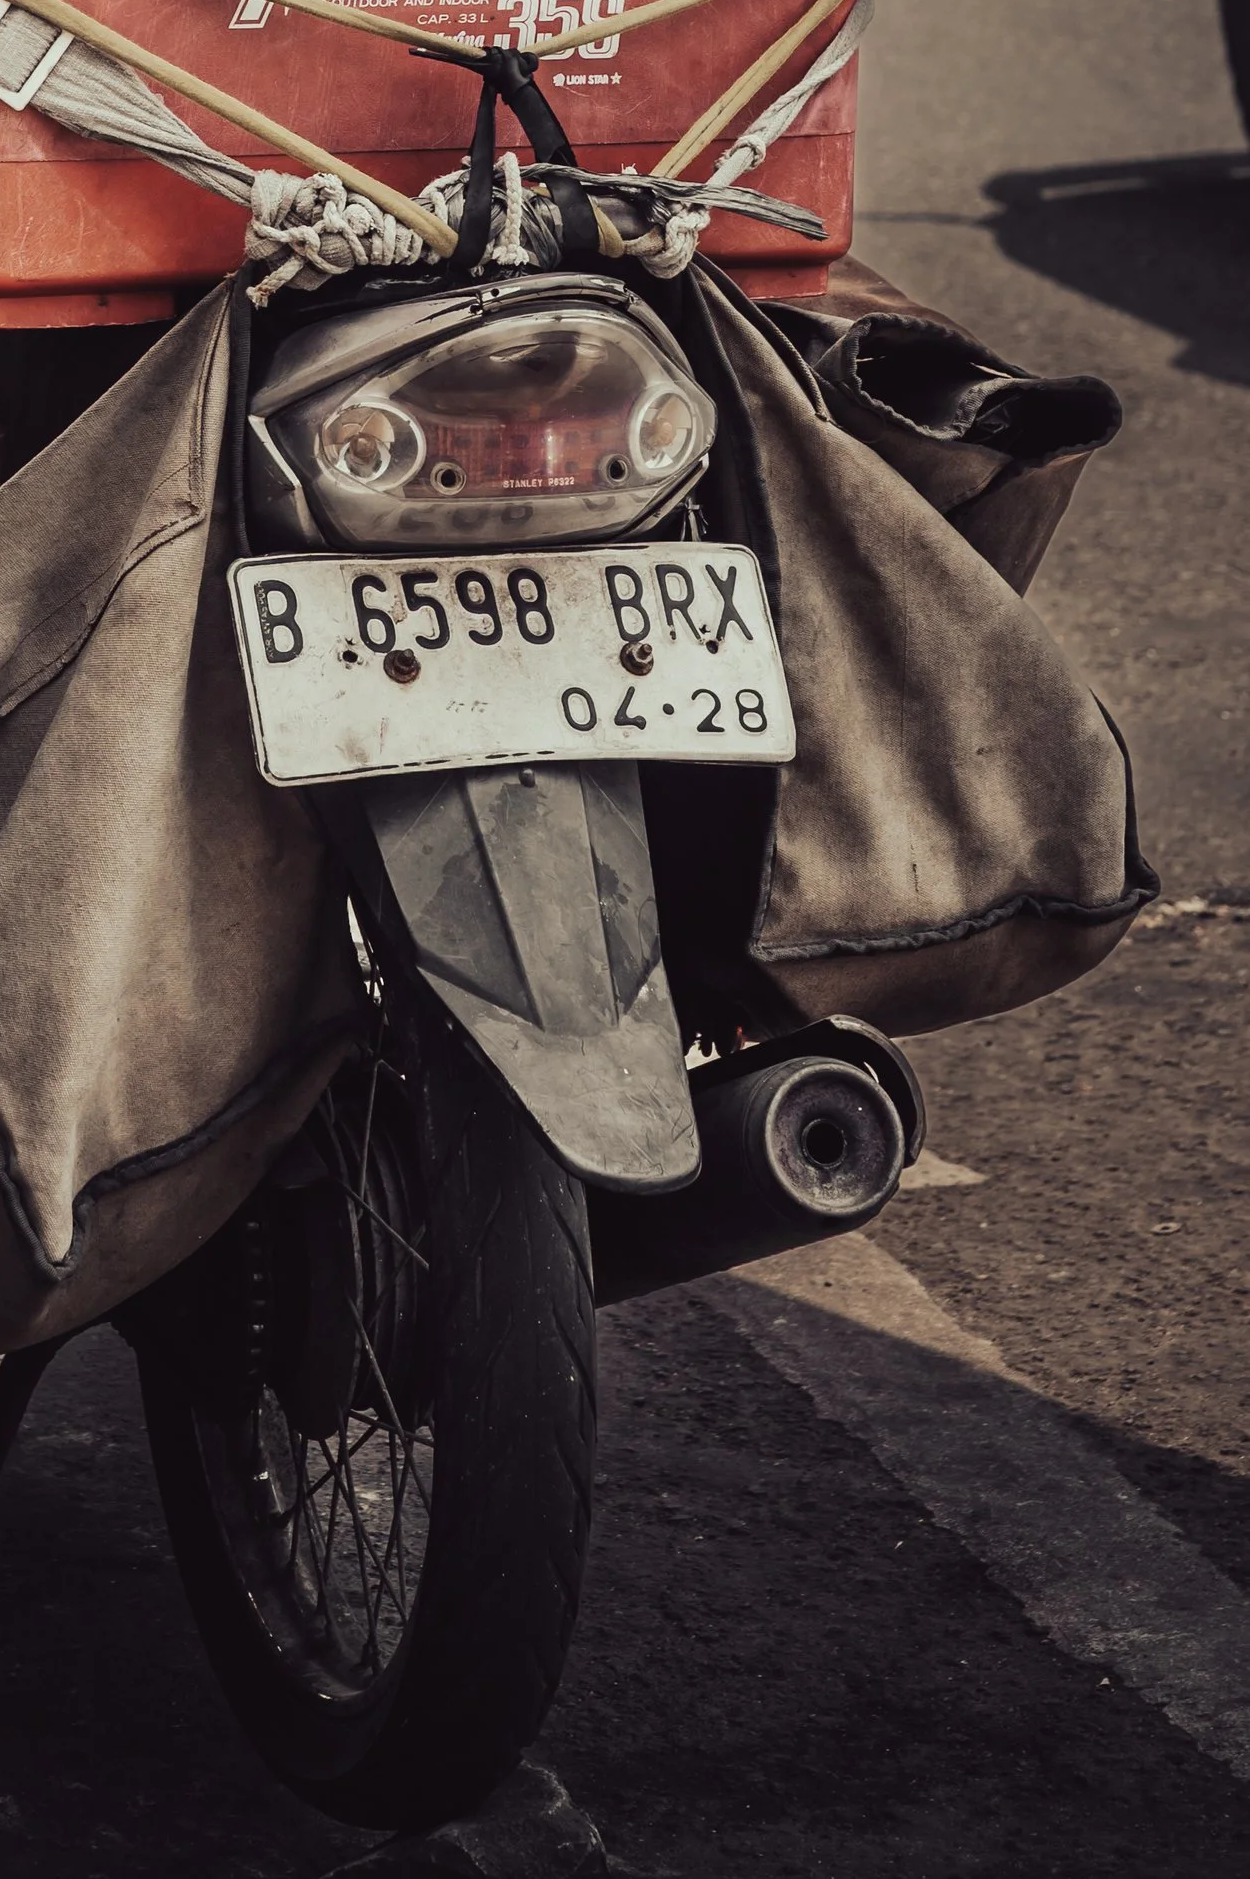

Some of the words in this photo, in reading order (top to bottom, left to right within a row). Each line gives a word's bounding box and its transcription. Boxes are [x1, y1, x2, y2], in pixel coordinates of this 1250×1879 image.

[417, 14, 451, 25] CAP.
[458, 13, 477, 23] 33
[480, 13, 489, 23] L
[566, 74, 587, 85] LION
[587, 74, 609, 85] STAR
[503, 478, 543, 489] STANLEY
[253, 579, 304, 664] B
[351, 568, 555, 654] 6598
[605, 564, 754, 643] BRX
